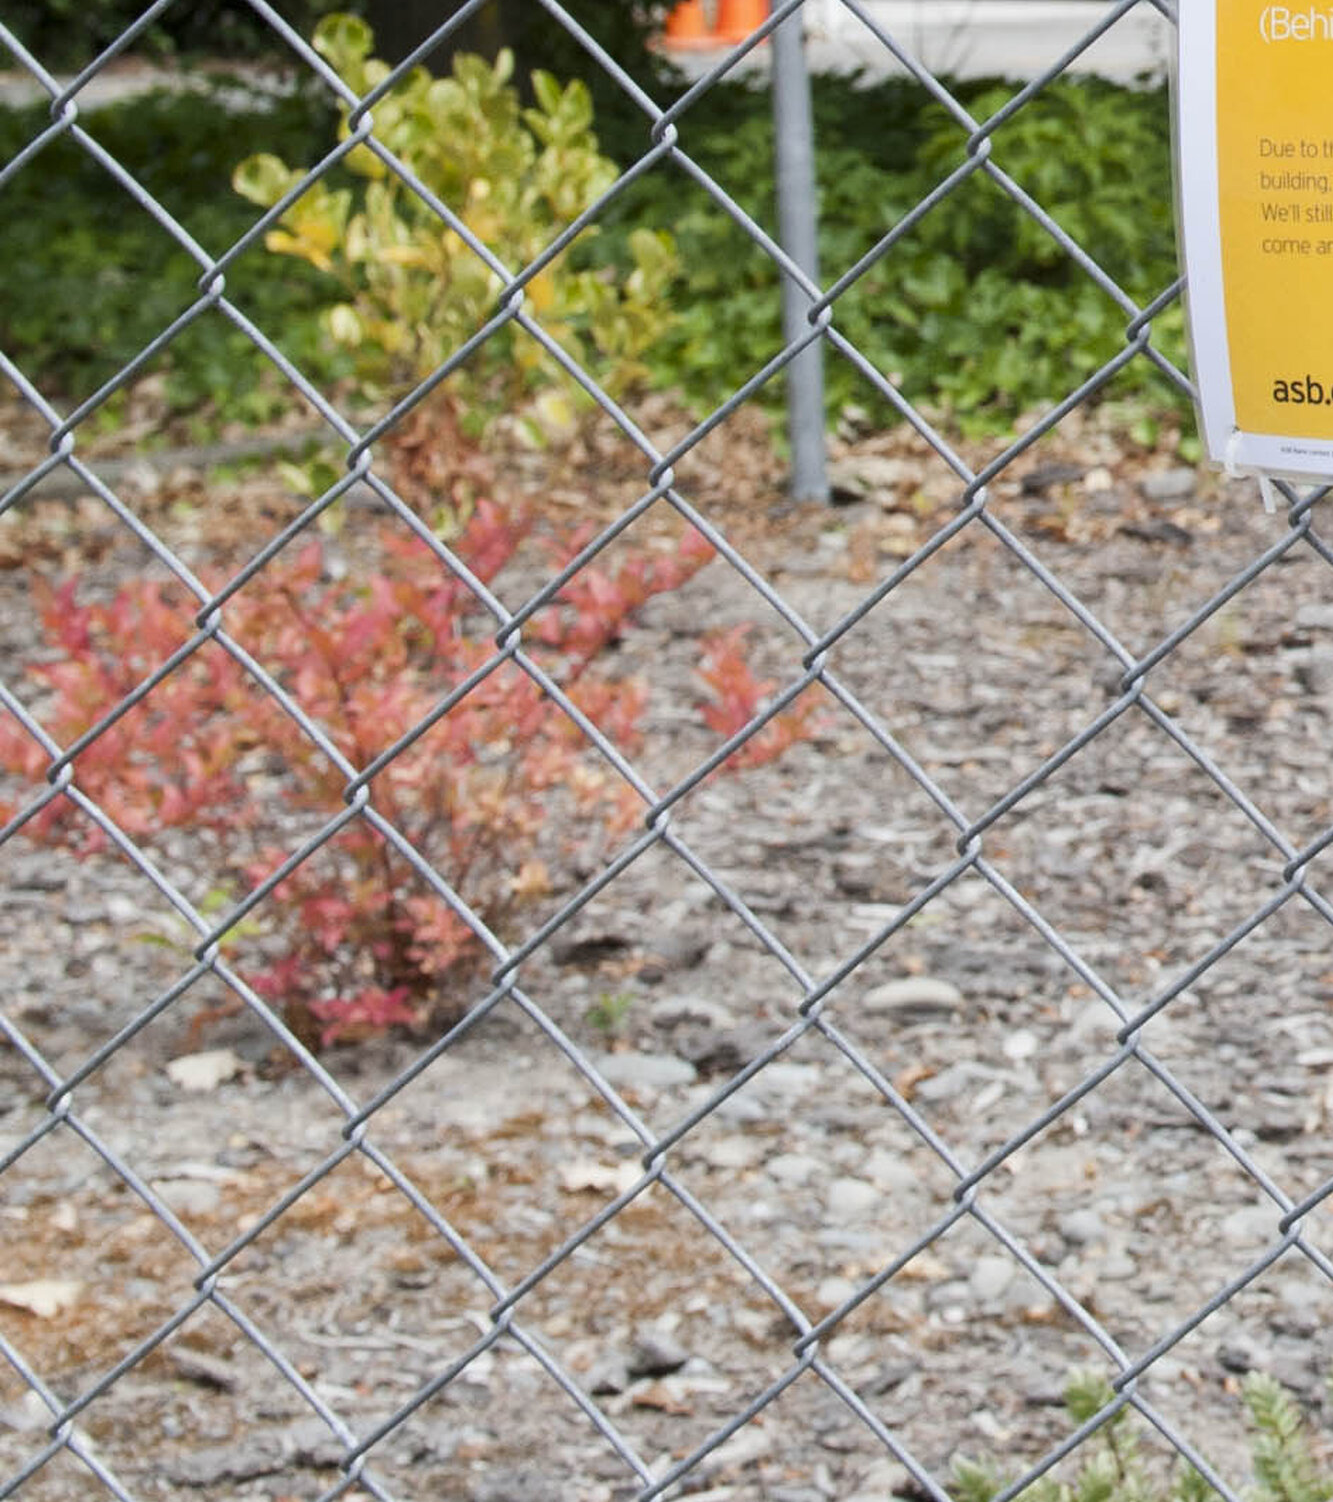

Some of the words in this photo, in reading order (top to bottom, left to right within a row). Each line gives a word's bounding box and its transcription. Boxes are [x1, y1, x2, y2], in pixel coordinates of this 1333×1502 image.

[1260, 138, 1295, 158] Due
[1300, 140, 1318, 158] to
[1262, 203, 1300, 222] We'll
[1306, 204, 1332, 222] still
[1262, 238, 1310, 254] come
